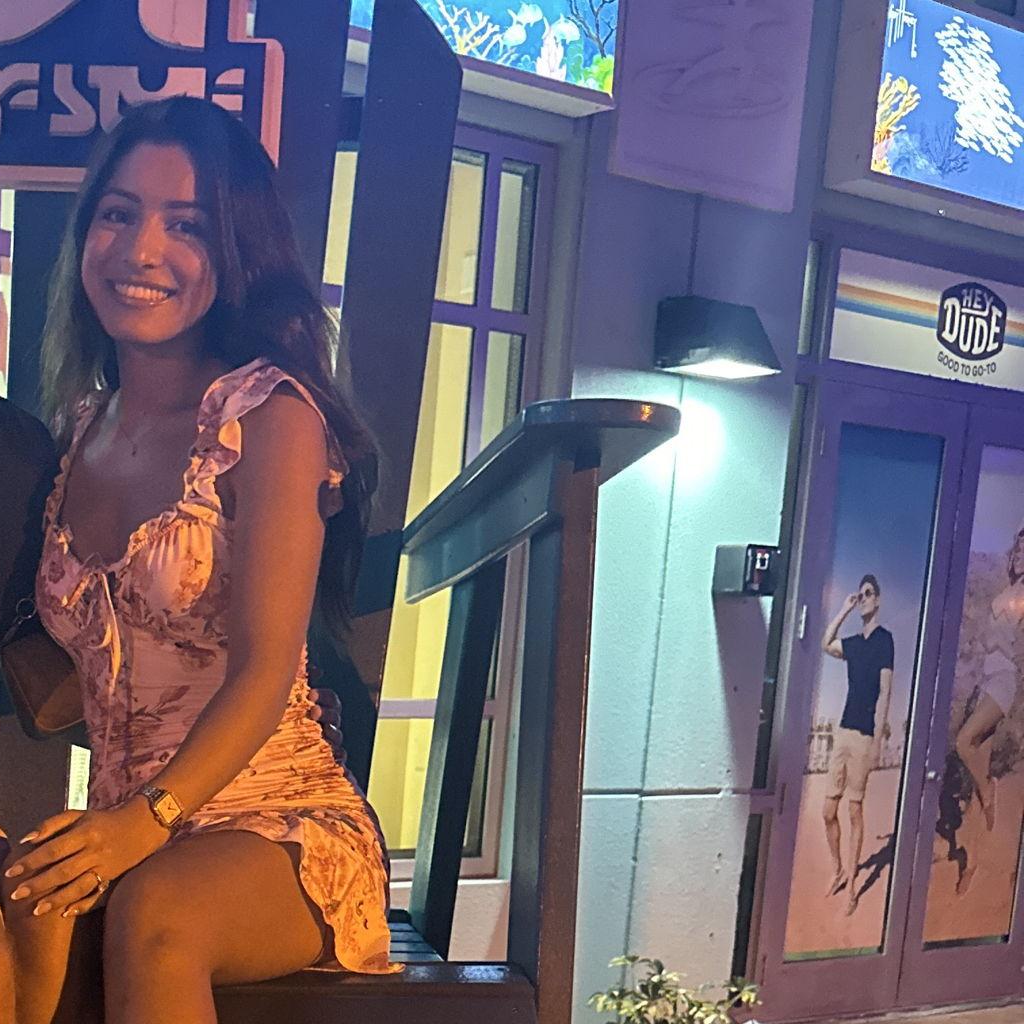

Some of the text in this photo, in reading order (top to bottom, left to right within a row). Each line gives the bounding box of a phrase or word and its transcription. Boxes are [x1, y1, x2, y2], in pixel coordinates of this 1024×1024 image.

[961, 288, 994, 317] HEY
[942, 297, 1003, 355] DUDE
[937, 351, 997, 377] GOOD TO GO-TO
